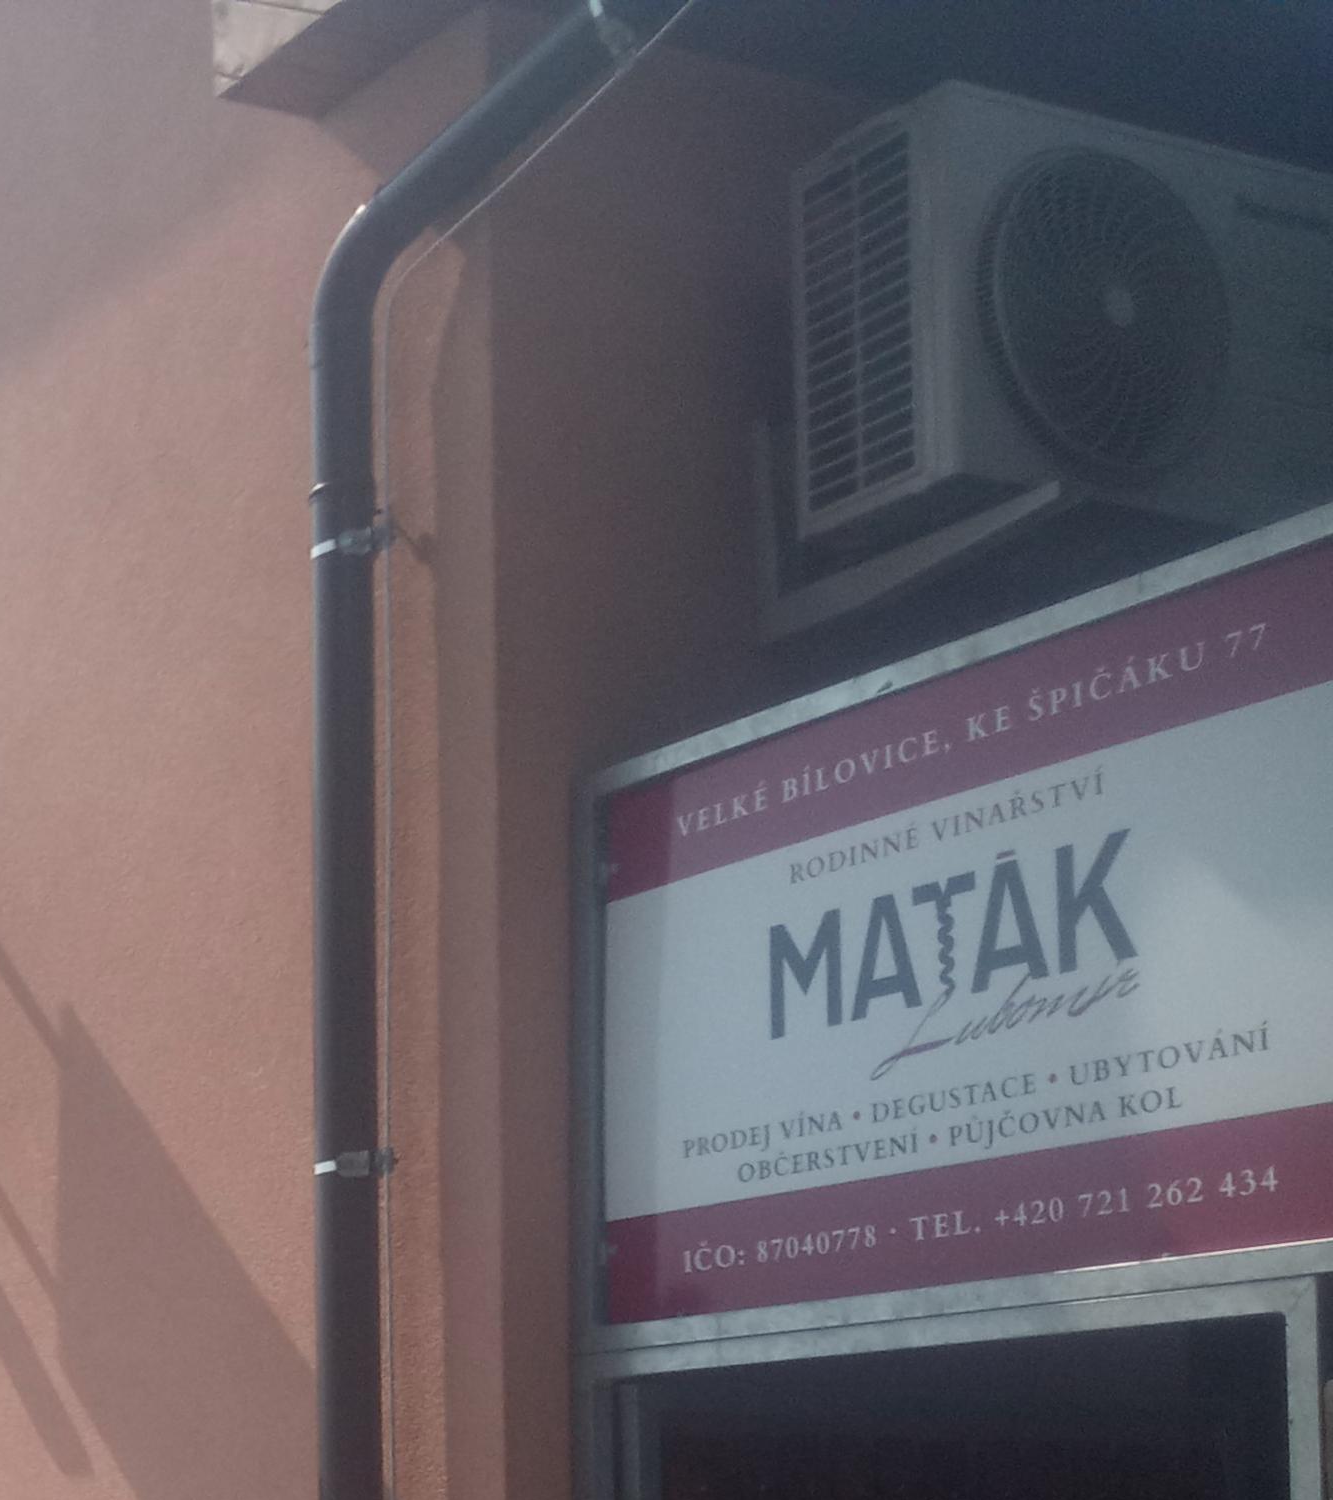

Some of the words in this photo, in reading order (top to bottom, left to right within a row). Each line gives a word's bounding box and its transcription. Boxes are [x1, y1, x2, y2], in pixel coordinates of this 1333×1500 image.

[676, 780, 769, 838] VELKÉ
[781, 727, 951, 804] BÍLOVICE,
[964, 703, 1012, 742] KE
[1027, 641, 1205, 722] ŠPIČÁKU
[1223, 621, 1267, 658] 77
[789, 824, 920, 885] RODINNÉ
[930, 765, 1106, 843] VINAŘSTVÍ
[682, 1122, 772, 1159] PRODEJ
[778, 1109, 844, 1141] VÍNA
[870, 1072, 1037, 1124] DEGUSTACE
[1068, 1020, 1270, 1087] UBYTOVÁNÍ
[736, 1127, 919, 1184] OBČERSTVENÍ
[948, 1101, 1107, 1150] PŮJČOVNA
[1117, 1085, 1184, 1119] KOL
[683, 1239, 746, 1274] IČO:
[755, 1223, 878, 1264] 87040778
[909, 1209, 982, 1242] TEL.
[993, 1197, 1065, 1228] +420
[1077, 1186, 1131, 1218] 721
[1146, 1175, 1204, 1210] 262
[1218, 1164, 1279, 1199] 434
